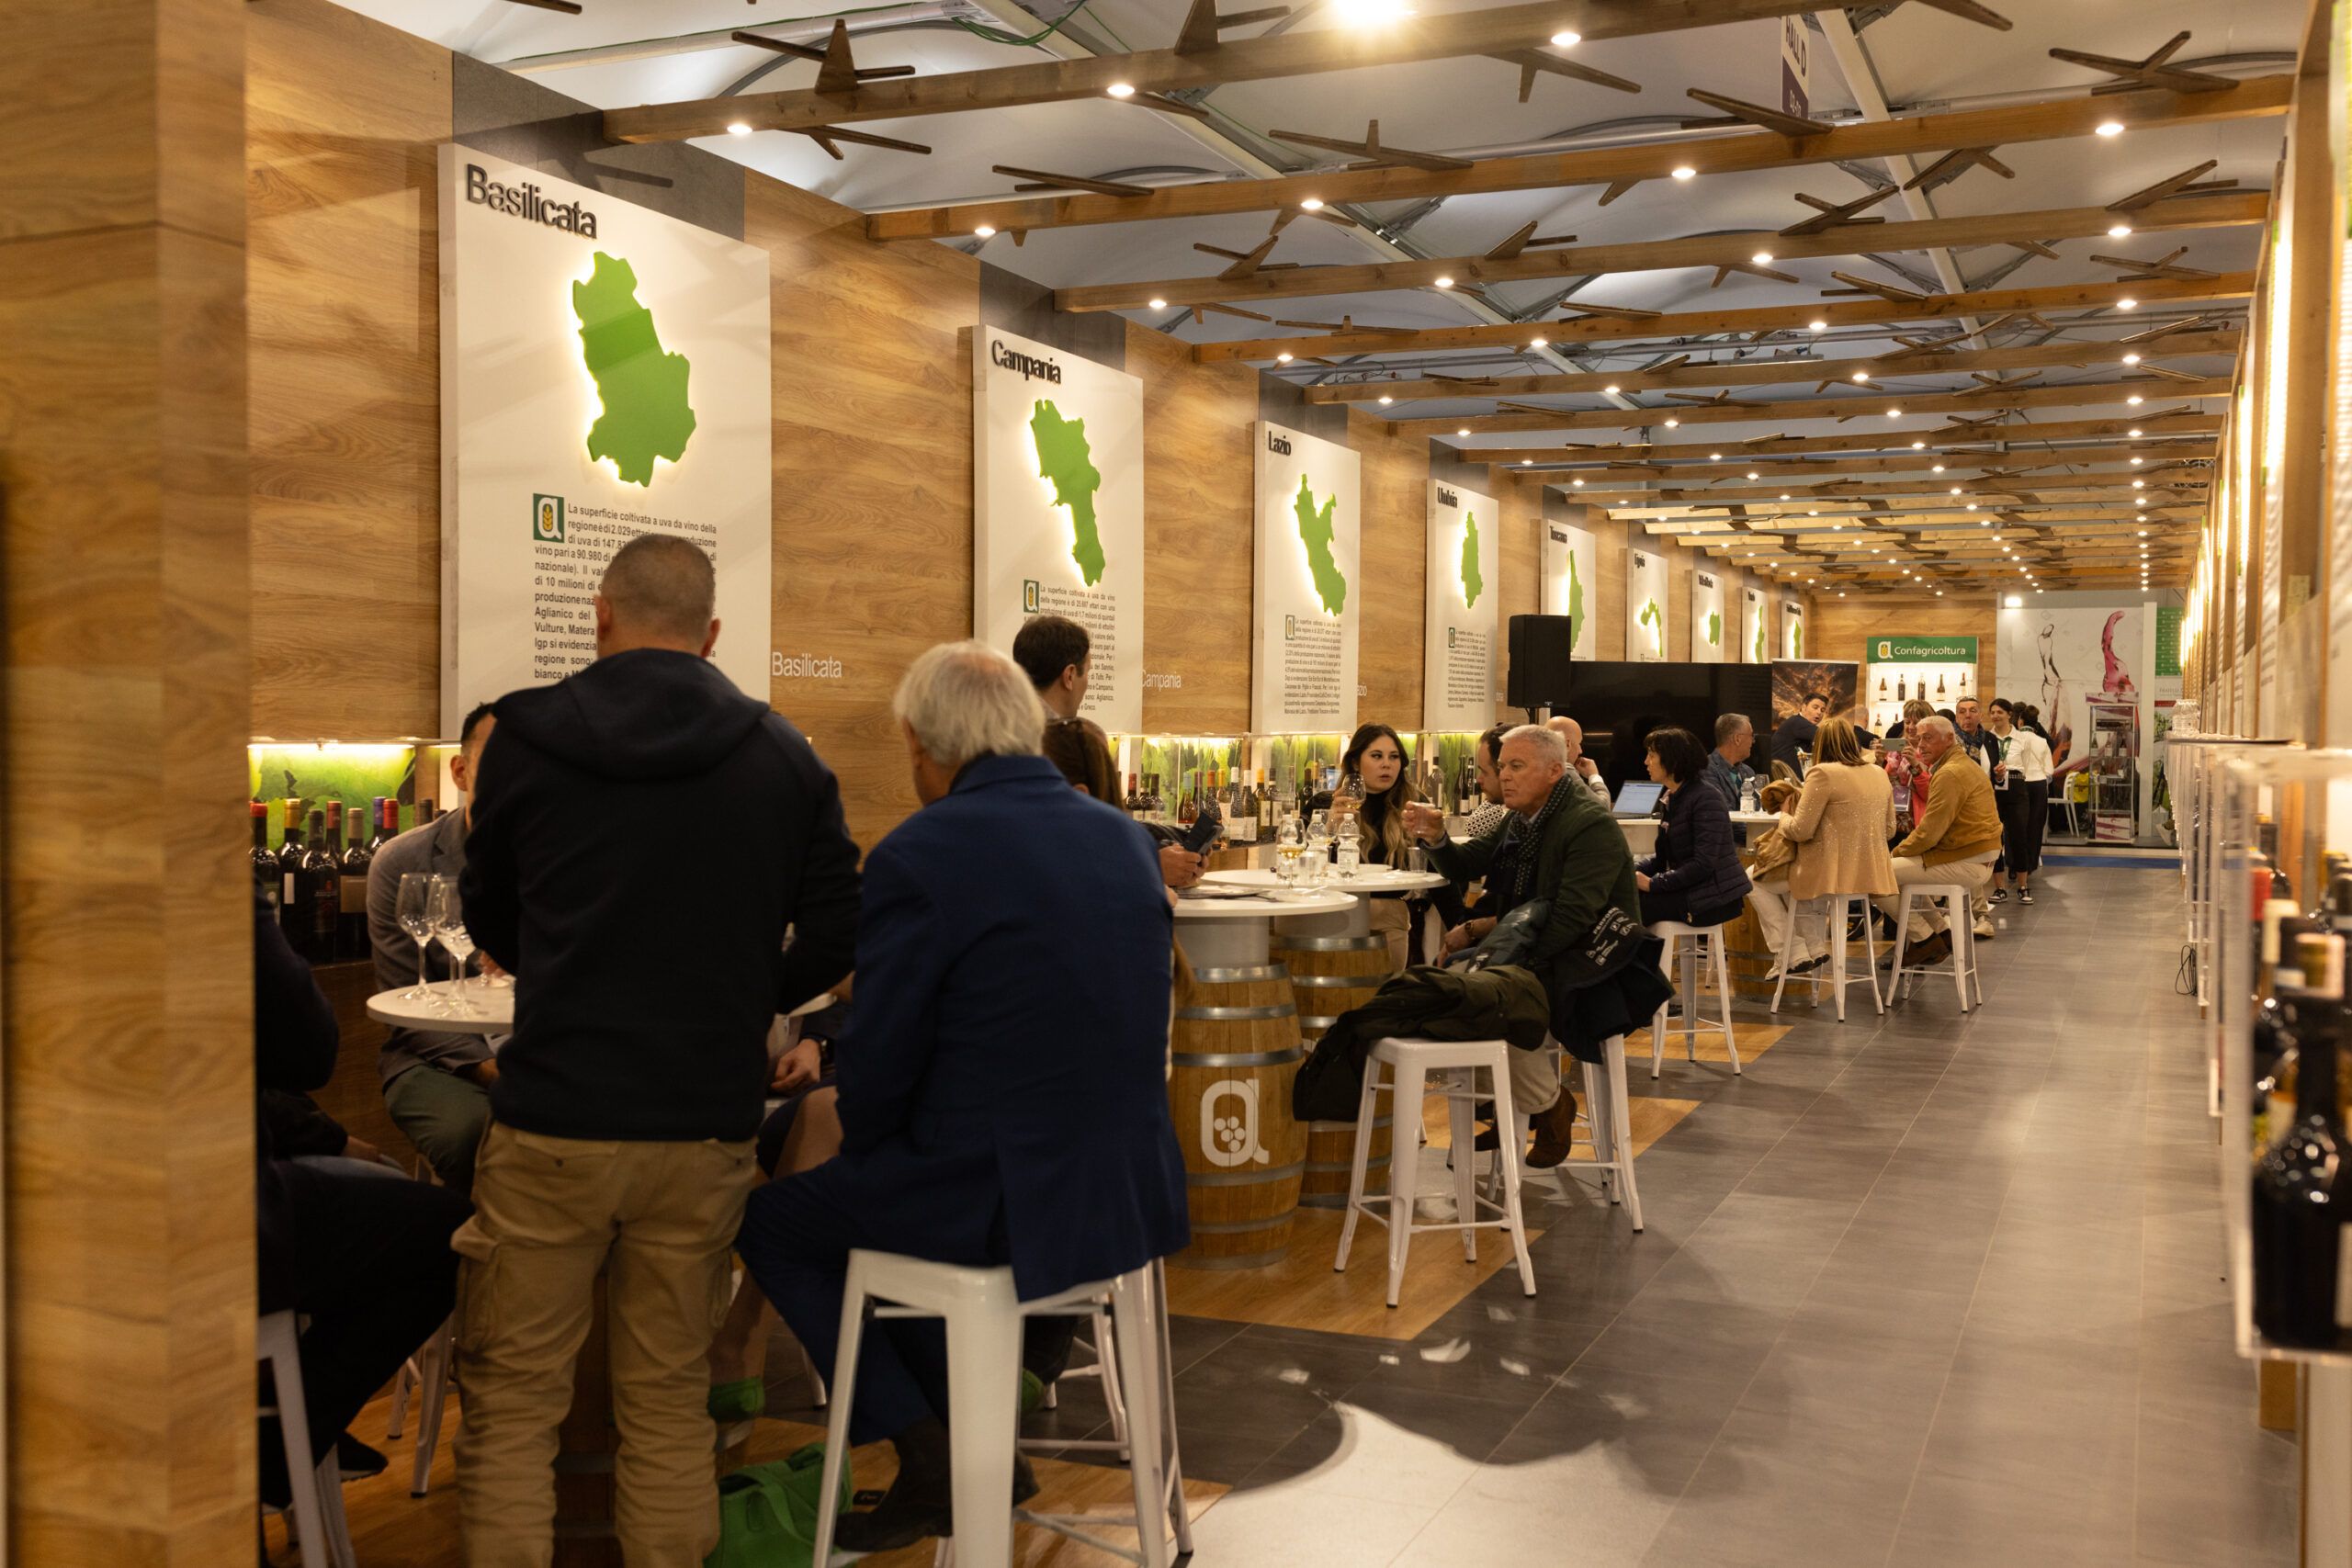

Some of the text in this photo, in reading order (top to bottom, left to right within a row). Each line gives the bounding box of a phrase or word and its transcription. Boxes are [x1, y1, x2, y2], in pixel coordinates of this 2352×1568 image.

[1801, 39, 1807, 77] D
[467, 164, 597, 239] Basilicata
[991, 339, 1061, 385] Campania
[1268, 430, 1292, 457] Lazio
[568, 502, 717, 534] La superficie coltivata a uva da vino della
[568, 520, 598, 532] regione
[604, 524, 611, 534] di
[568, 534, 576, 544] di
[577, 536, 592, 547] uva
[593, 536, 601, 547] di
[535, 544, 553, 556] vino
[554, 547, 570, 558] pari
[571, 550, 575, 558] a
[603, 553, 611, 562] di
[535, 561, 580, 576] nazionale).
[535, 576, 543, 586] di
[546, 577, 556, 587] 10
[558, 578, 585, 590] milioni
[588, 581, 595, 591] di
[535, 592, 581, 604] produzione
[535, 606, 591, 621] Aglianico del
[535, 622, 595, 636] Vulture, Matera
[549, 639, 558, 649] si
[1894, 646, 1966, 657] Confagricoltura
[535, 654, 566, 666] regione
[772, 651, 842, 678] Basilicata
[535, 669, 562, 679] bianco
